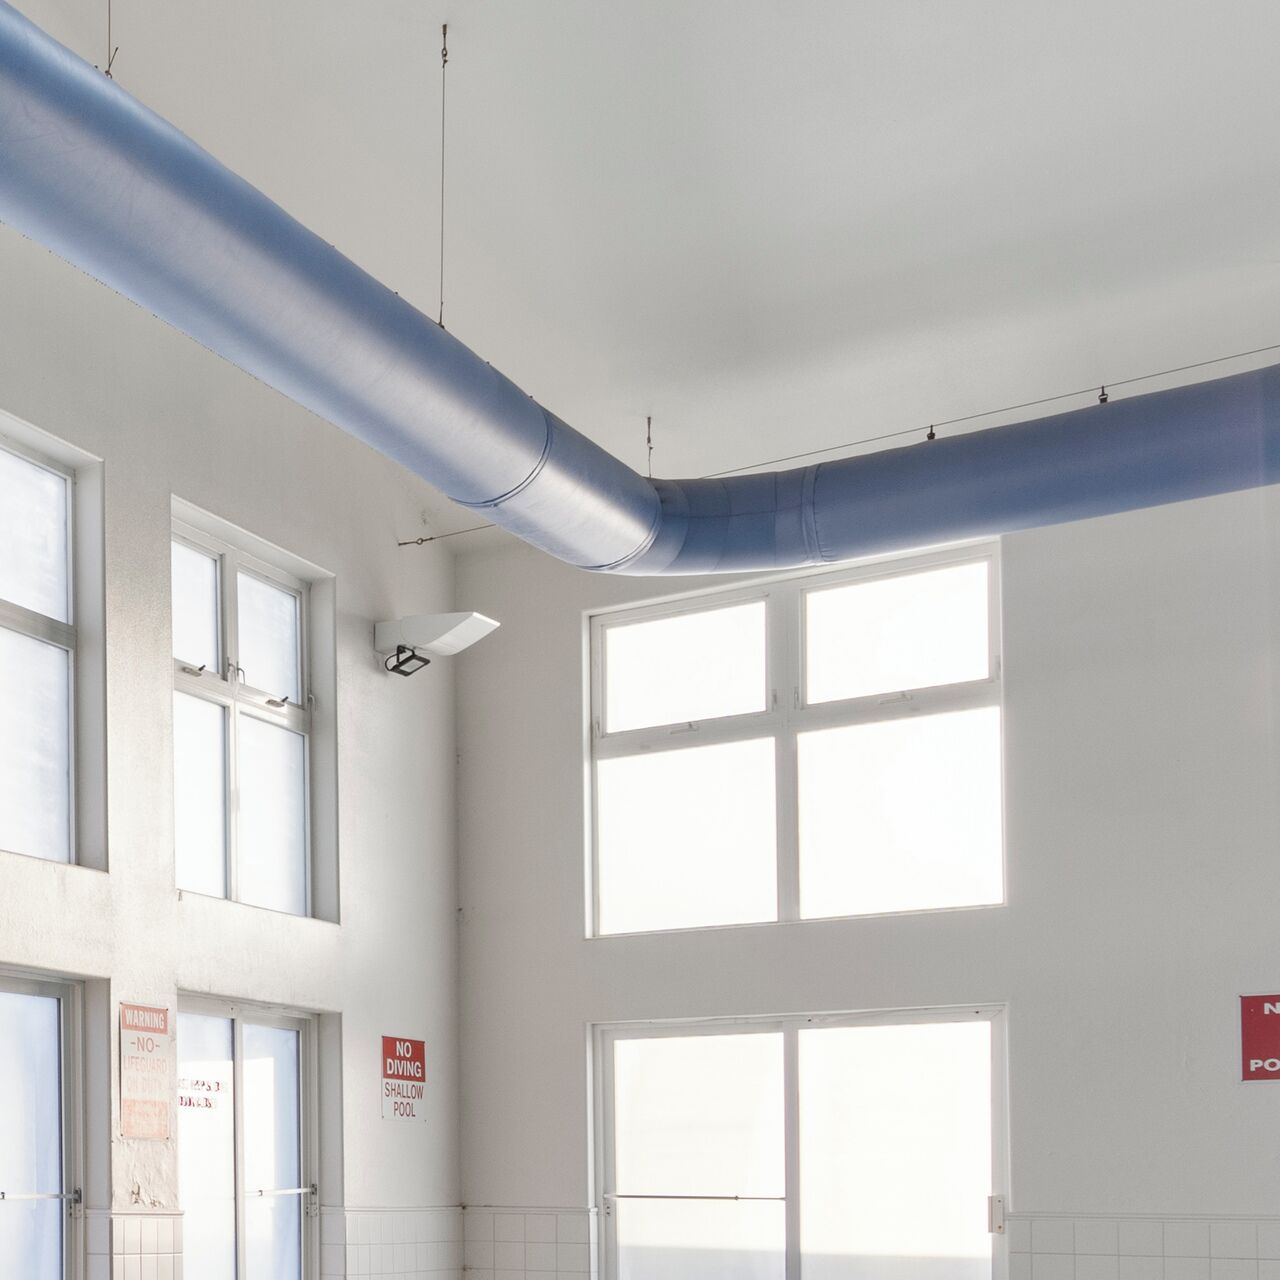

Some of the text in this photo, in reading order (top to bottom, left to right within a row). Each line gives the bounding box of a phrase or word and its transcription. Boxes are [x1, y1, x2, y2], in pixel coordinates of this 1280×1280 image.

[125, 1007, 165, 1029] WARNING
[396, 1040, 412, 1058] NO
[124, 1055, 167, 1073] LIFEGUARD
[386, 1058, 422, 1078] DIVING
[384, 1082, 424, 1100] SHALLOW
[394, 1101, 416, 1117] POOL
